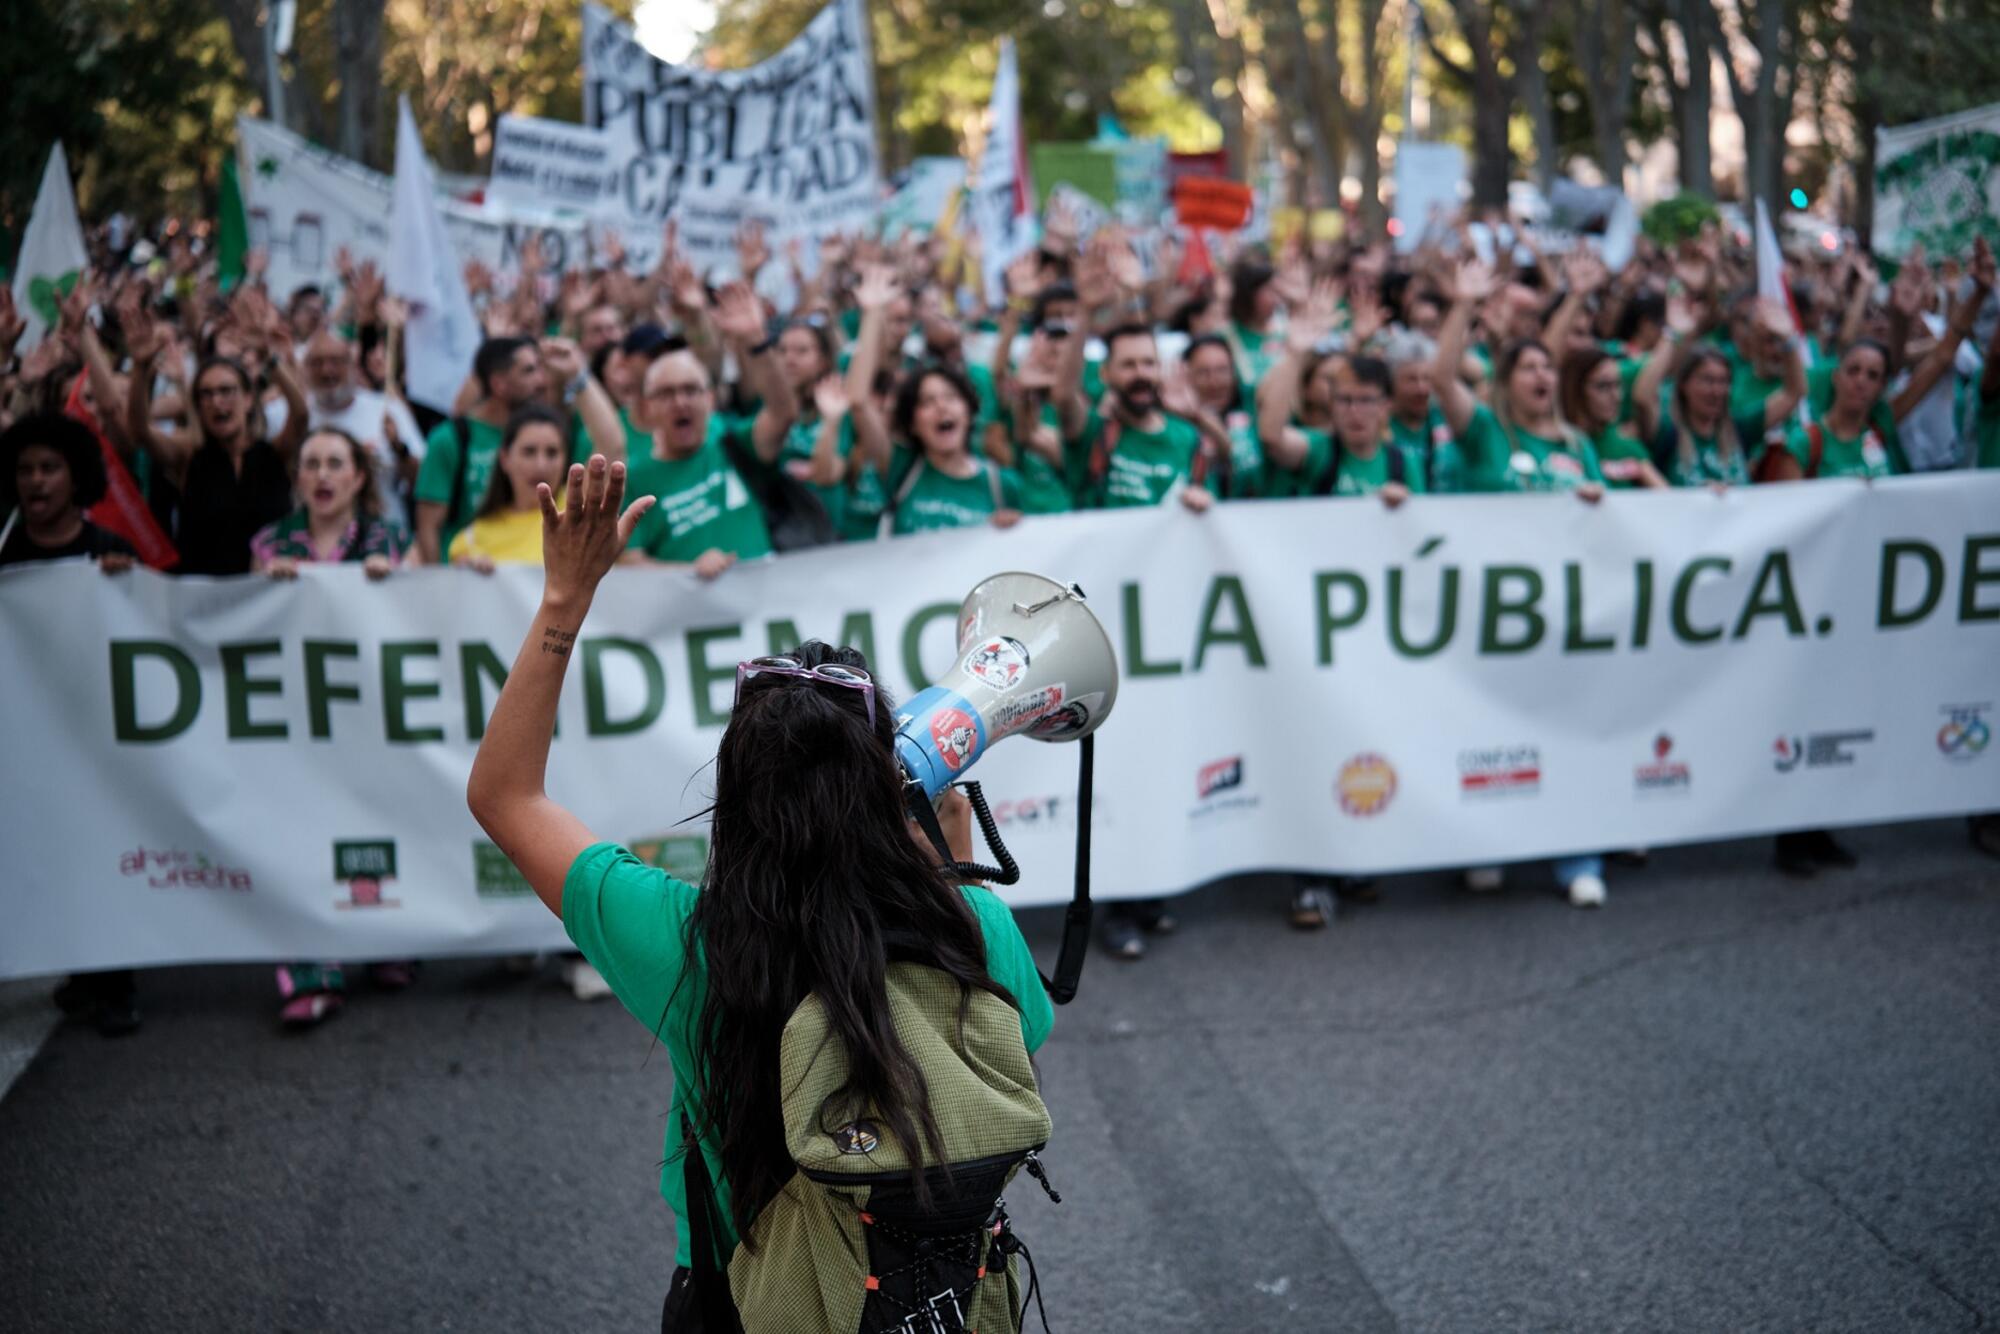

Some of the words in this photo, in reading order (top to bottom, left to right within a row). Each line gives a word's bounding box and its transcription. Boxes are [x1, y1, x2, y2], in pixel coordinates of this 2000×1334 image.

[108, 600, 960, 744] DEFENDEMO
[1121, 575, 1267, 677] LA
[1314, 536, 1836, 667] PÚBLICA.
